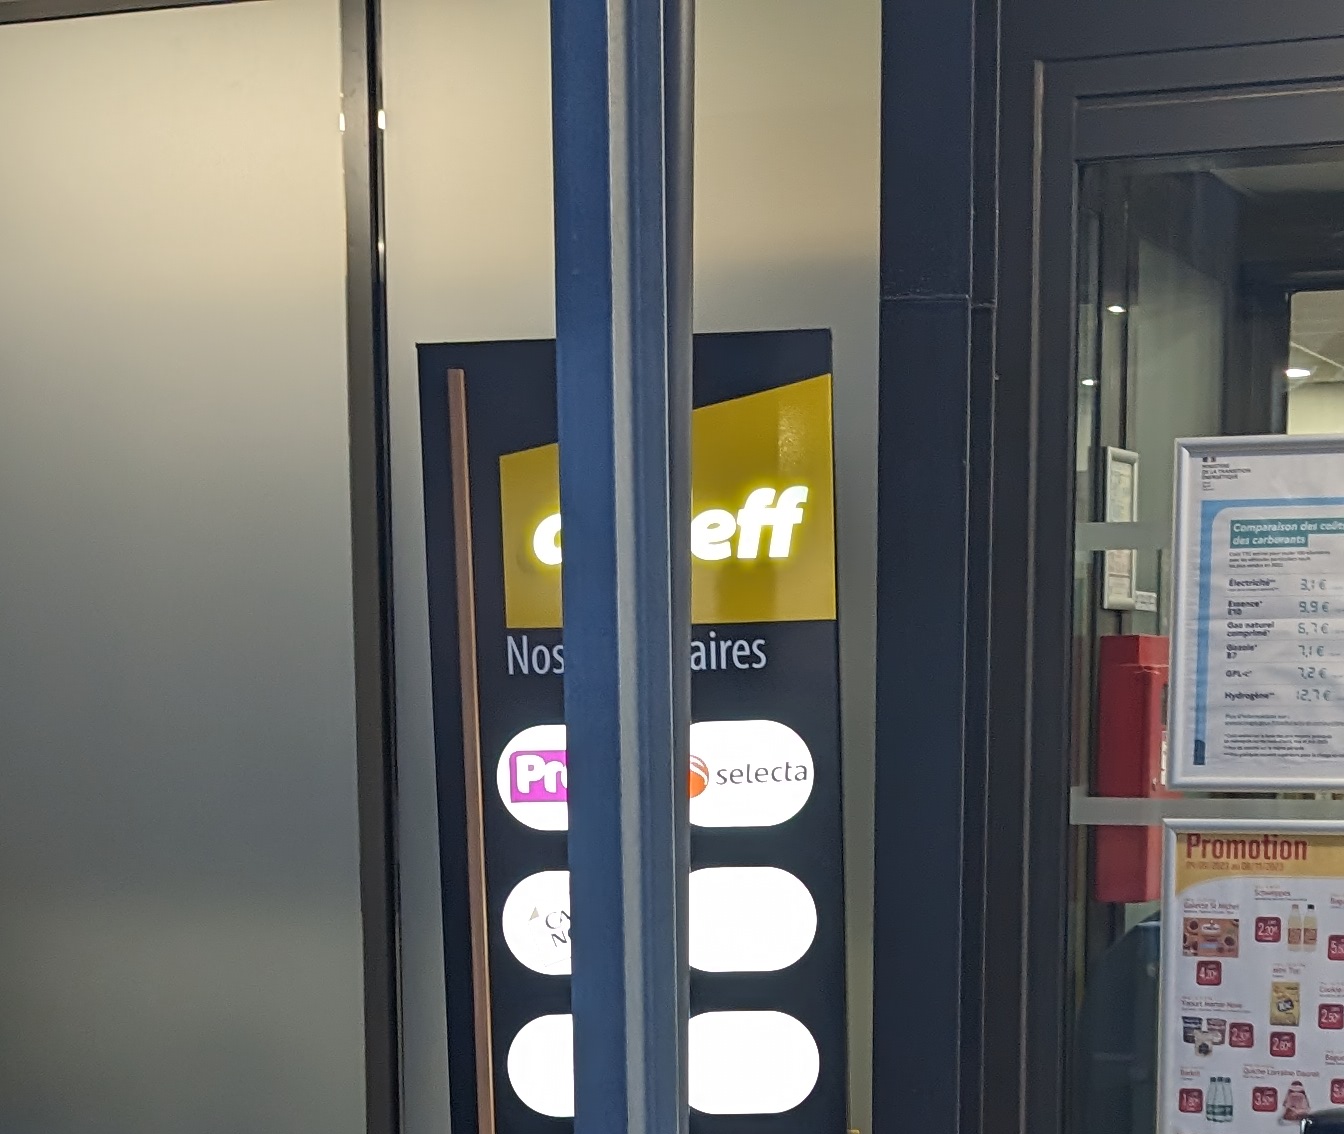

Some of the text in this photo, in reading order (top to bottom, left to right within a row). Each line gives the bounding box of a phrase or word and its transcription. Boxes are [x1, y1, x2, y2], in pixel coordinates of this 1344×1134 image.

[1233, 521, 1297, 534] Comparaison
[1300, 521, 1318, 531] des
[1233, 536, 1249, 545] des
[507, 635, 565, 676] Nos
[716, 760, 808, 786] selecta
[1186, 833, 1308, 860] Promotion
